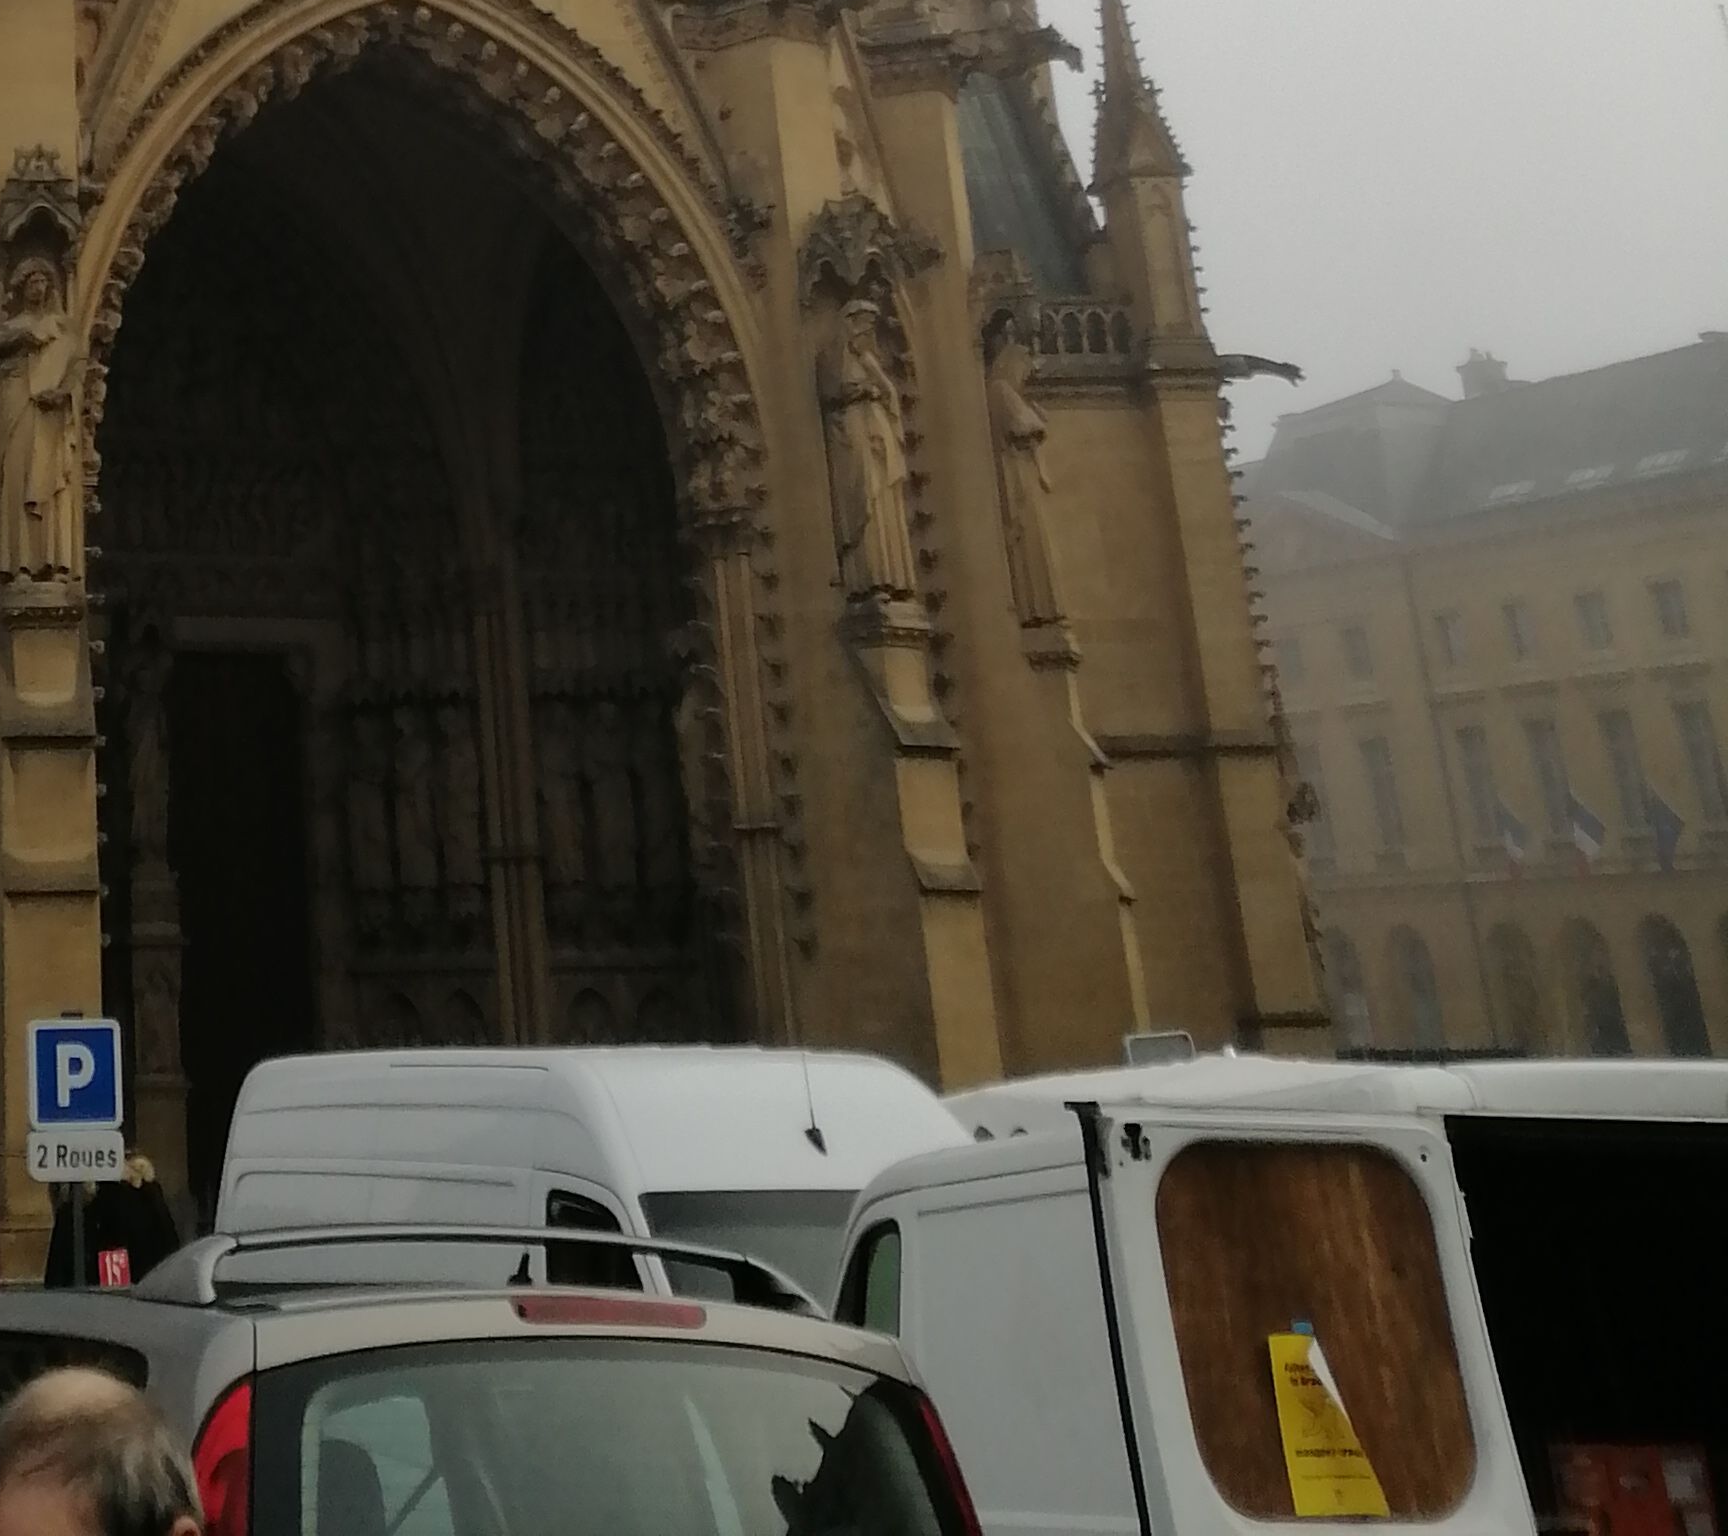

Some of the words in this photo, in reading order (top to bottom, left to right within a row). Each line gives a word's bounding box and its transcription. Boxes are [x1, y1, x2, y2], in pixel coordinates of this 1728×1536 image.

[56, 1042, 95, 1108] P
[37, 1144, 48, 1169] 2
[57, 1144, 117, 1169] Roues
